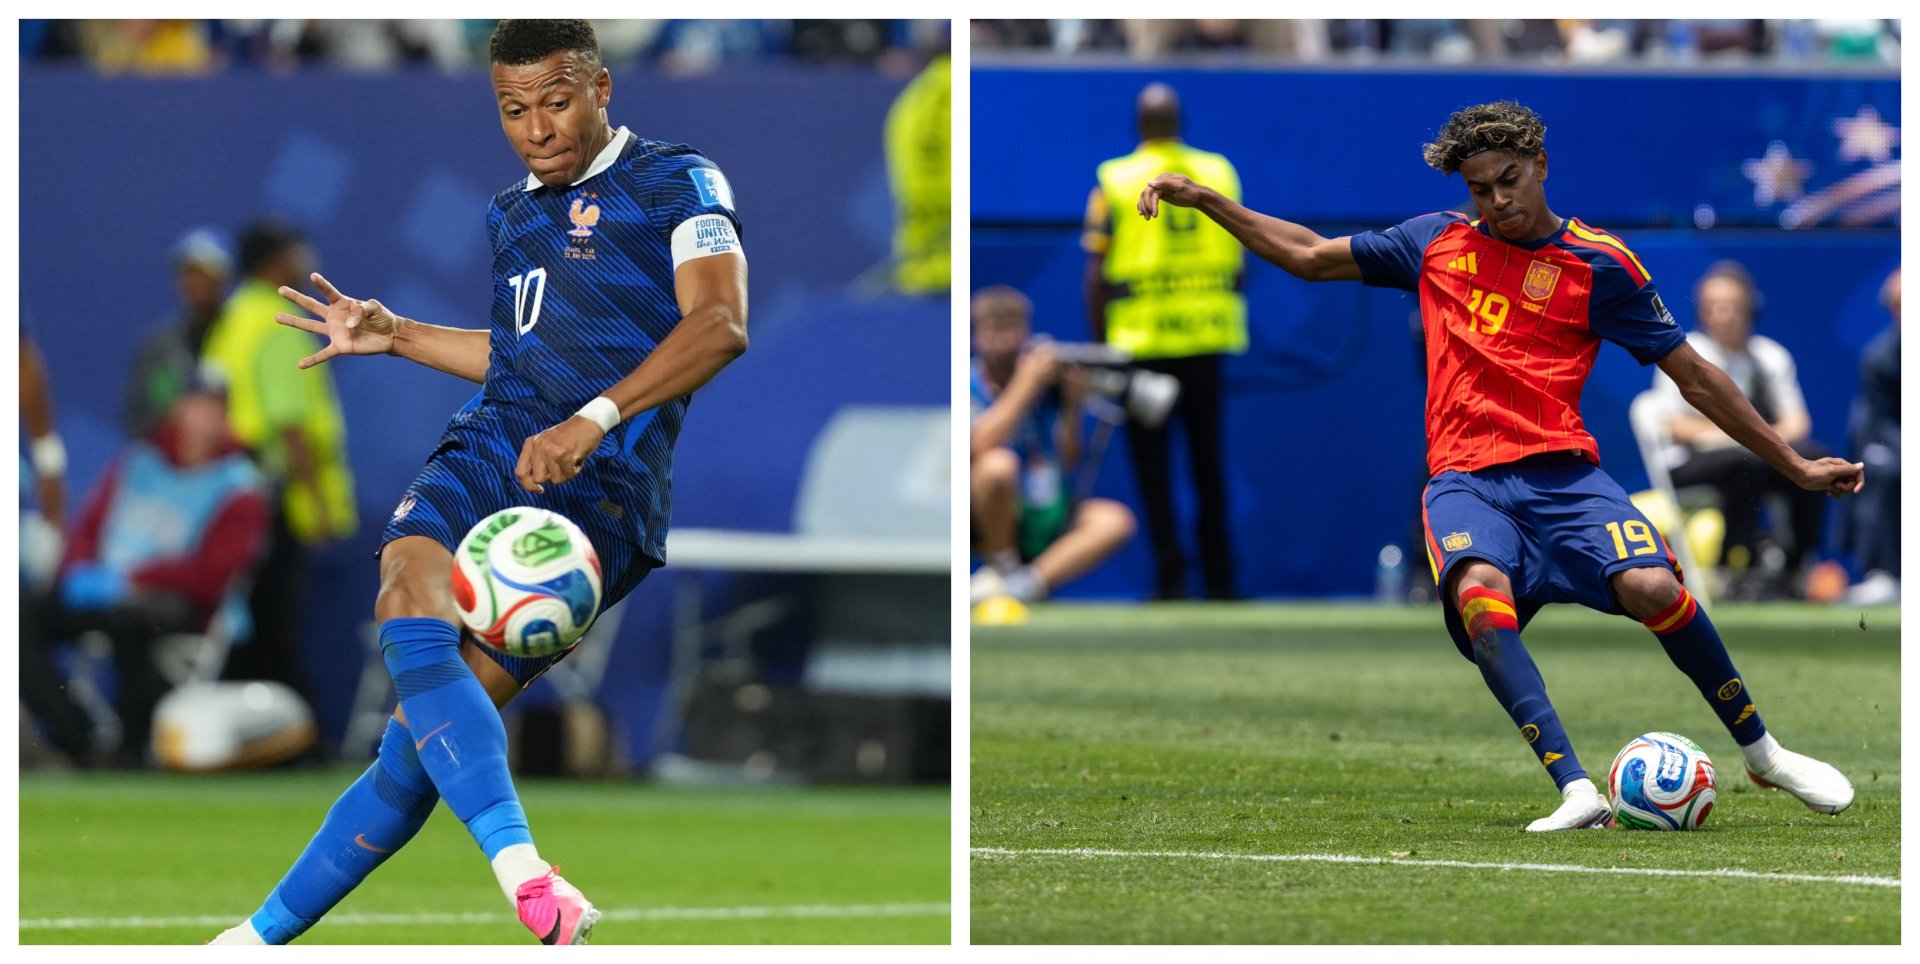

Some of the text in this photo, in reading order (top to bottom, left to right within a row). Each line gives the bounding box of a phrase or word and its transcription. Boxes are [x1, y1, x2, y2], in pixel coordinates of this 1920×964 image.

[695, 240, 712, 248] the
[508, 267, 547, 341] 10
[1468, 289, 1509, 335] 19
[1605, 520, 1658, 560] 19
